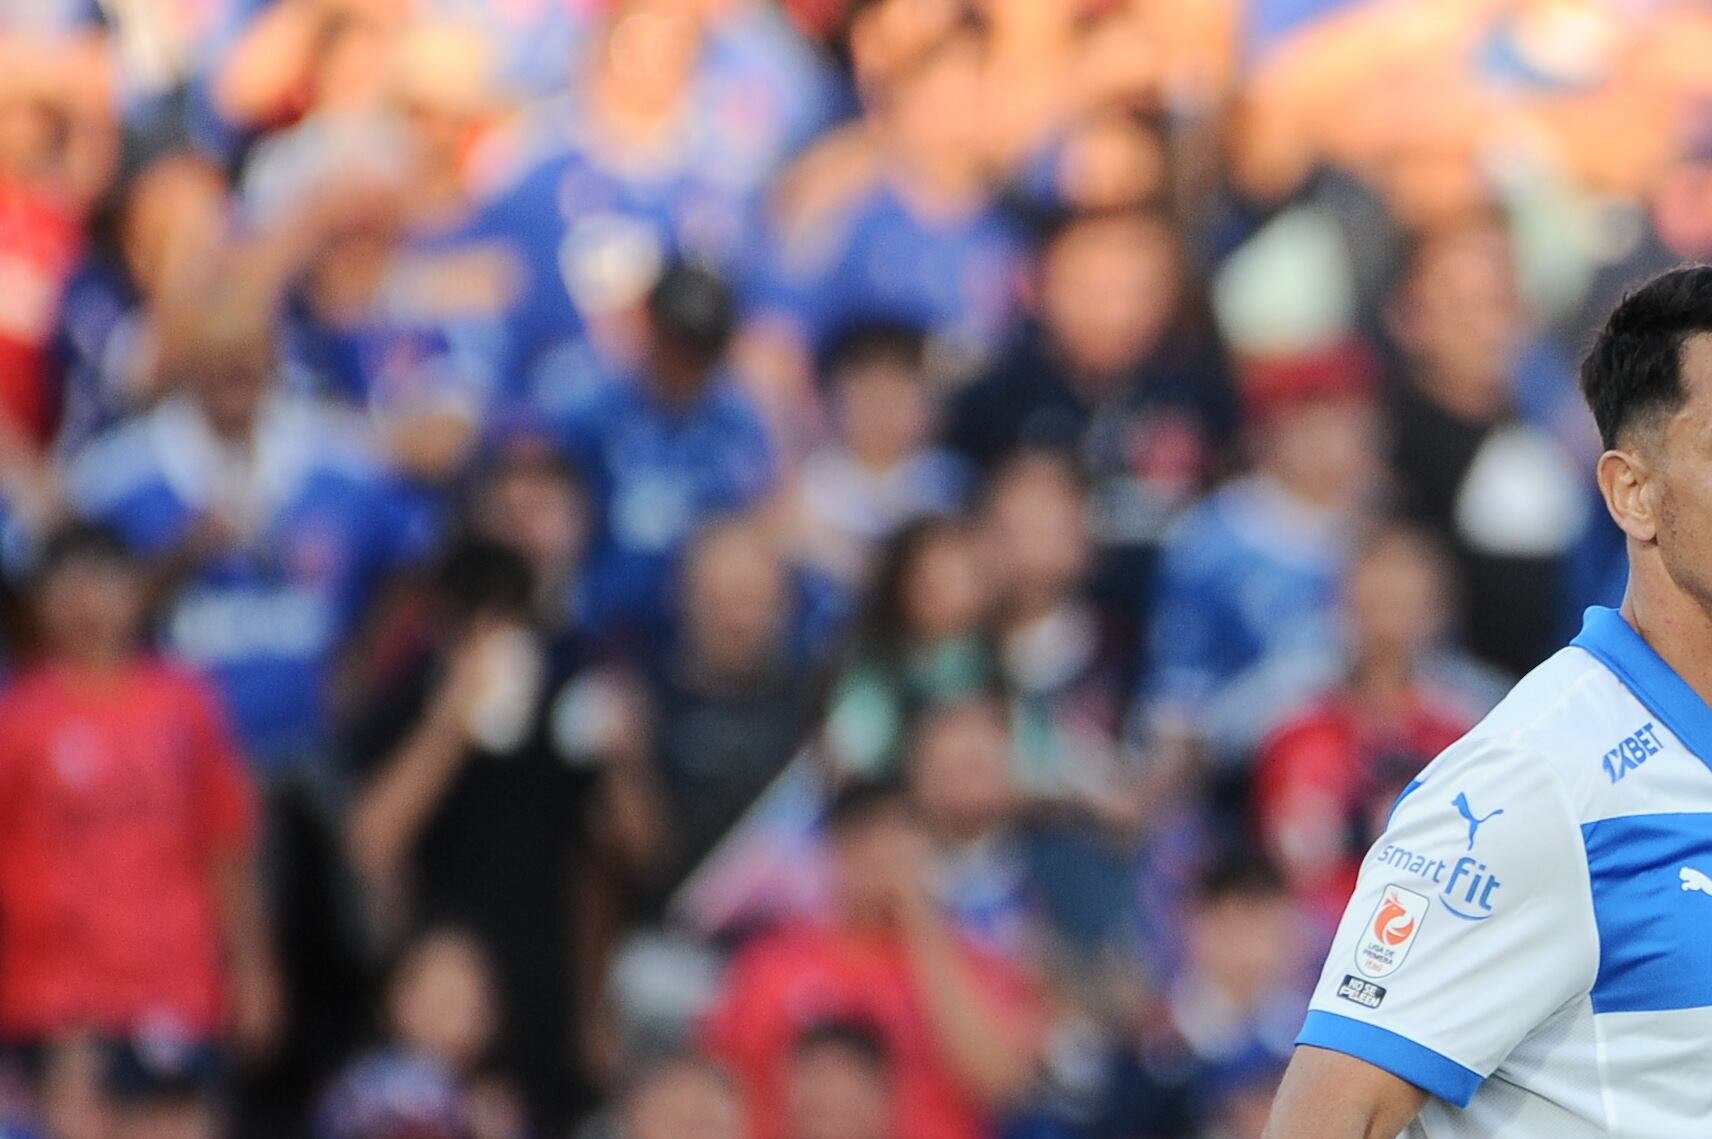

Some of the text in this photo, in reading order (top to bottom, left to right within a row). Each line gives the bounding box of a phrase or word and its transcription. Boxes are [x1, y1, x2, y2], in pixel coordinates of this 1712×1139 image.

[1602, 722, 1664, 784] 1XBET
[1377, 845, 1501, 911] smart fit
